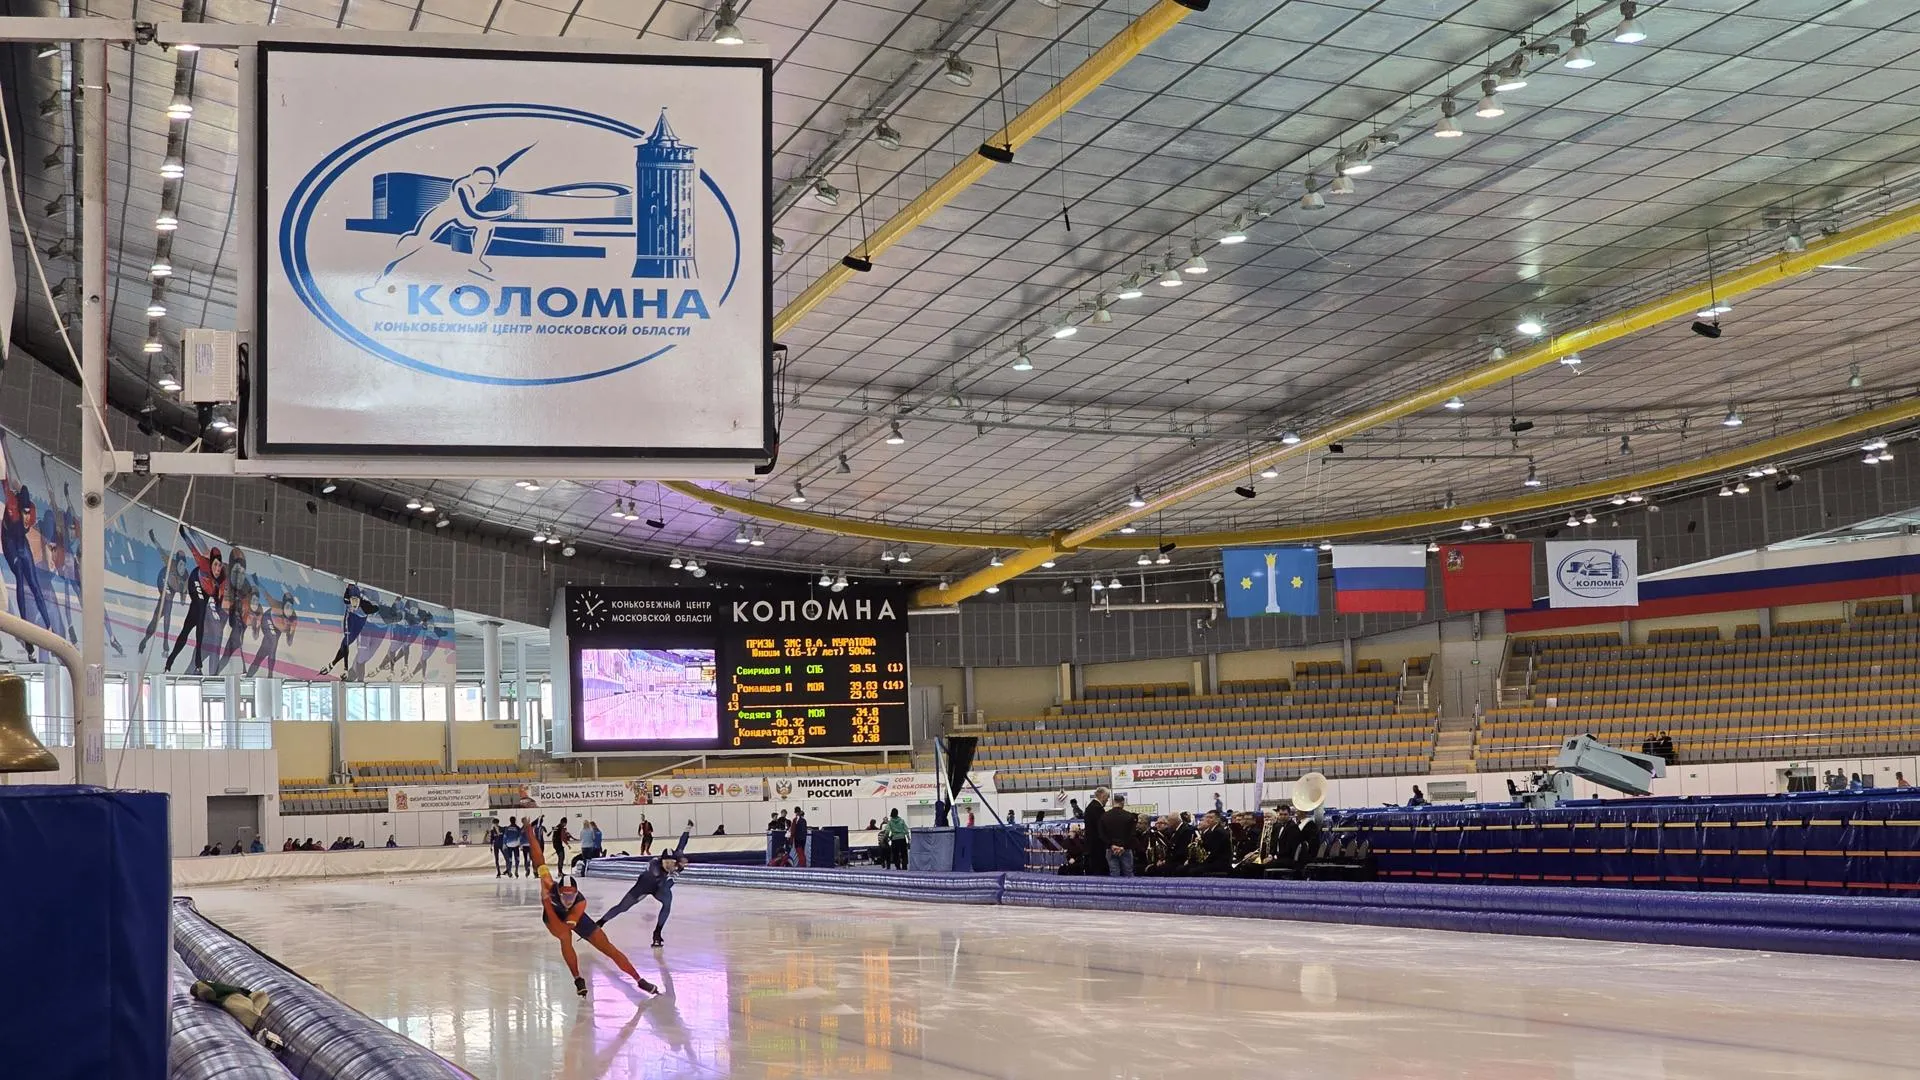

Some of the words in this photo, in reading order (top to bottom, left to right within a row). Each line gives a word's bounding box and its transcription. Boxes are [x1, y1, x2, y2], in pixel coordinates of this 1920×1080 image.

[407, 284, 711, 319] КОЛОМНА
[374, 321, 488, 334] КОНЬКОБЕЖНЫЙ
[493, 323, 533, 336] ЦЕНТР
[535, 323, 628, 336] МОСКОВСКОЙ
[632, 325, 691, 337] ОБЛАСТИ
[611, 600, 681, 609] КОНЬКОБЕЖНЫЙ
[686, 601, 711, 610] ЦЕНТР
[733, 598, 897, 623] КОЛОМНА
[611, 613, 671, 622] МОСКОВСКОЙ
[675, 614, 712, 622] ОБЛАСТИ
[746, 639, 775, 649] ПРИЗЫ
[784, 638, 801, 648] ЗМС
[832, 637, 877, 647] МУРАТОВА
[752, 649, 780, 657] Юноши
[785, 647, 818, 657] (16-17
[821, 647, 844, 656] лет)
[736, 666, 781, 676] Свиридов
[806, 664, 824, 674] СПБ
[849, 663, 877, 673] 38.51
[887, 662, 903, 672] (1)
[736, 683, 782, 693] Романцев
[883, 680, 905, 690] (14)
[850, 690, 878, 700] 29.06
[727, 702, 739, 711] 13
[856, 707, 879, 717] 34.8
[770, 717, 805, 727] -00.32
[851, 716, 879, 726] 10.29
[738, 727, 795, 737] Кондратьев
[808, 726, 826, 735] СПБ
[856, 725, 880, 734] 34.8
[771, 735, 806, 745] -00.23
[852, 734, 880, 743] 10.38
[1137, 768, 1199, 778] ЛОР-ОРГАНОВ
[797, 778, 861, 788] МИНСПОРТ
[540, 792, 581, 800] KOLOMNA
[581, 791, 604, 799] TASTY
[606, 790, 624, 798] FISH
[807, 789, 853, 798] РОССИИ
